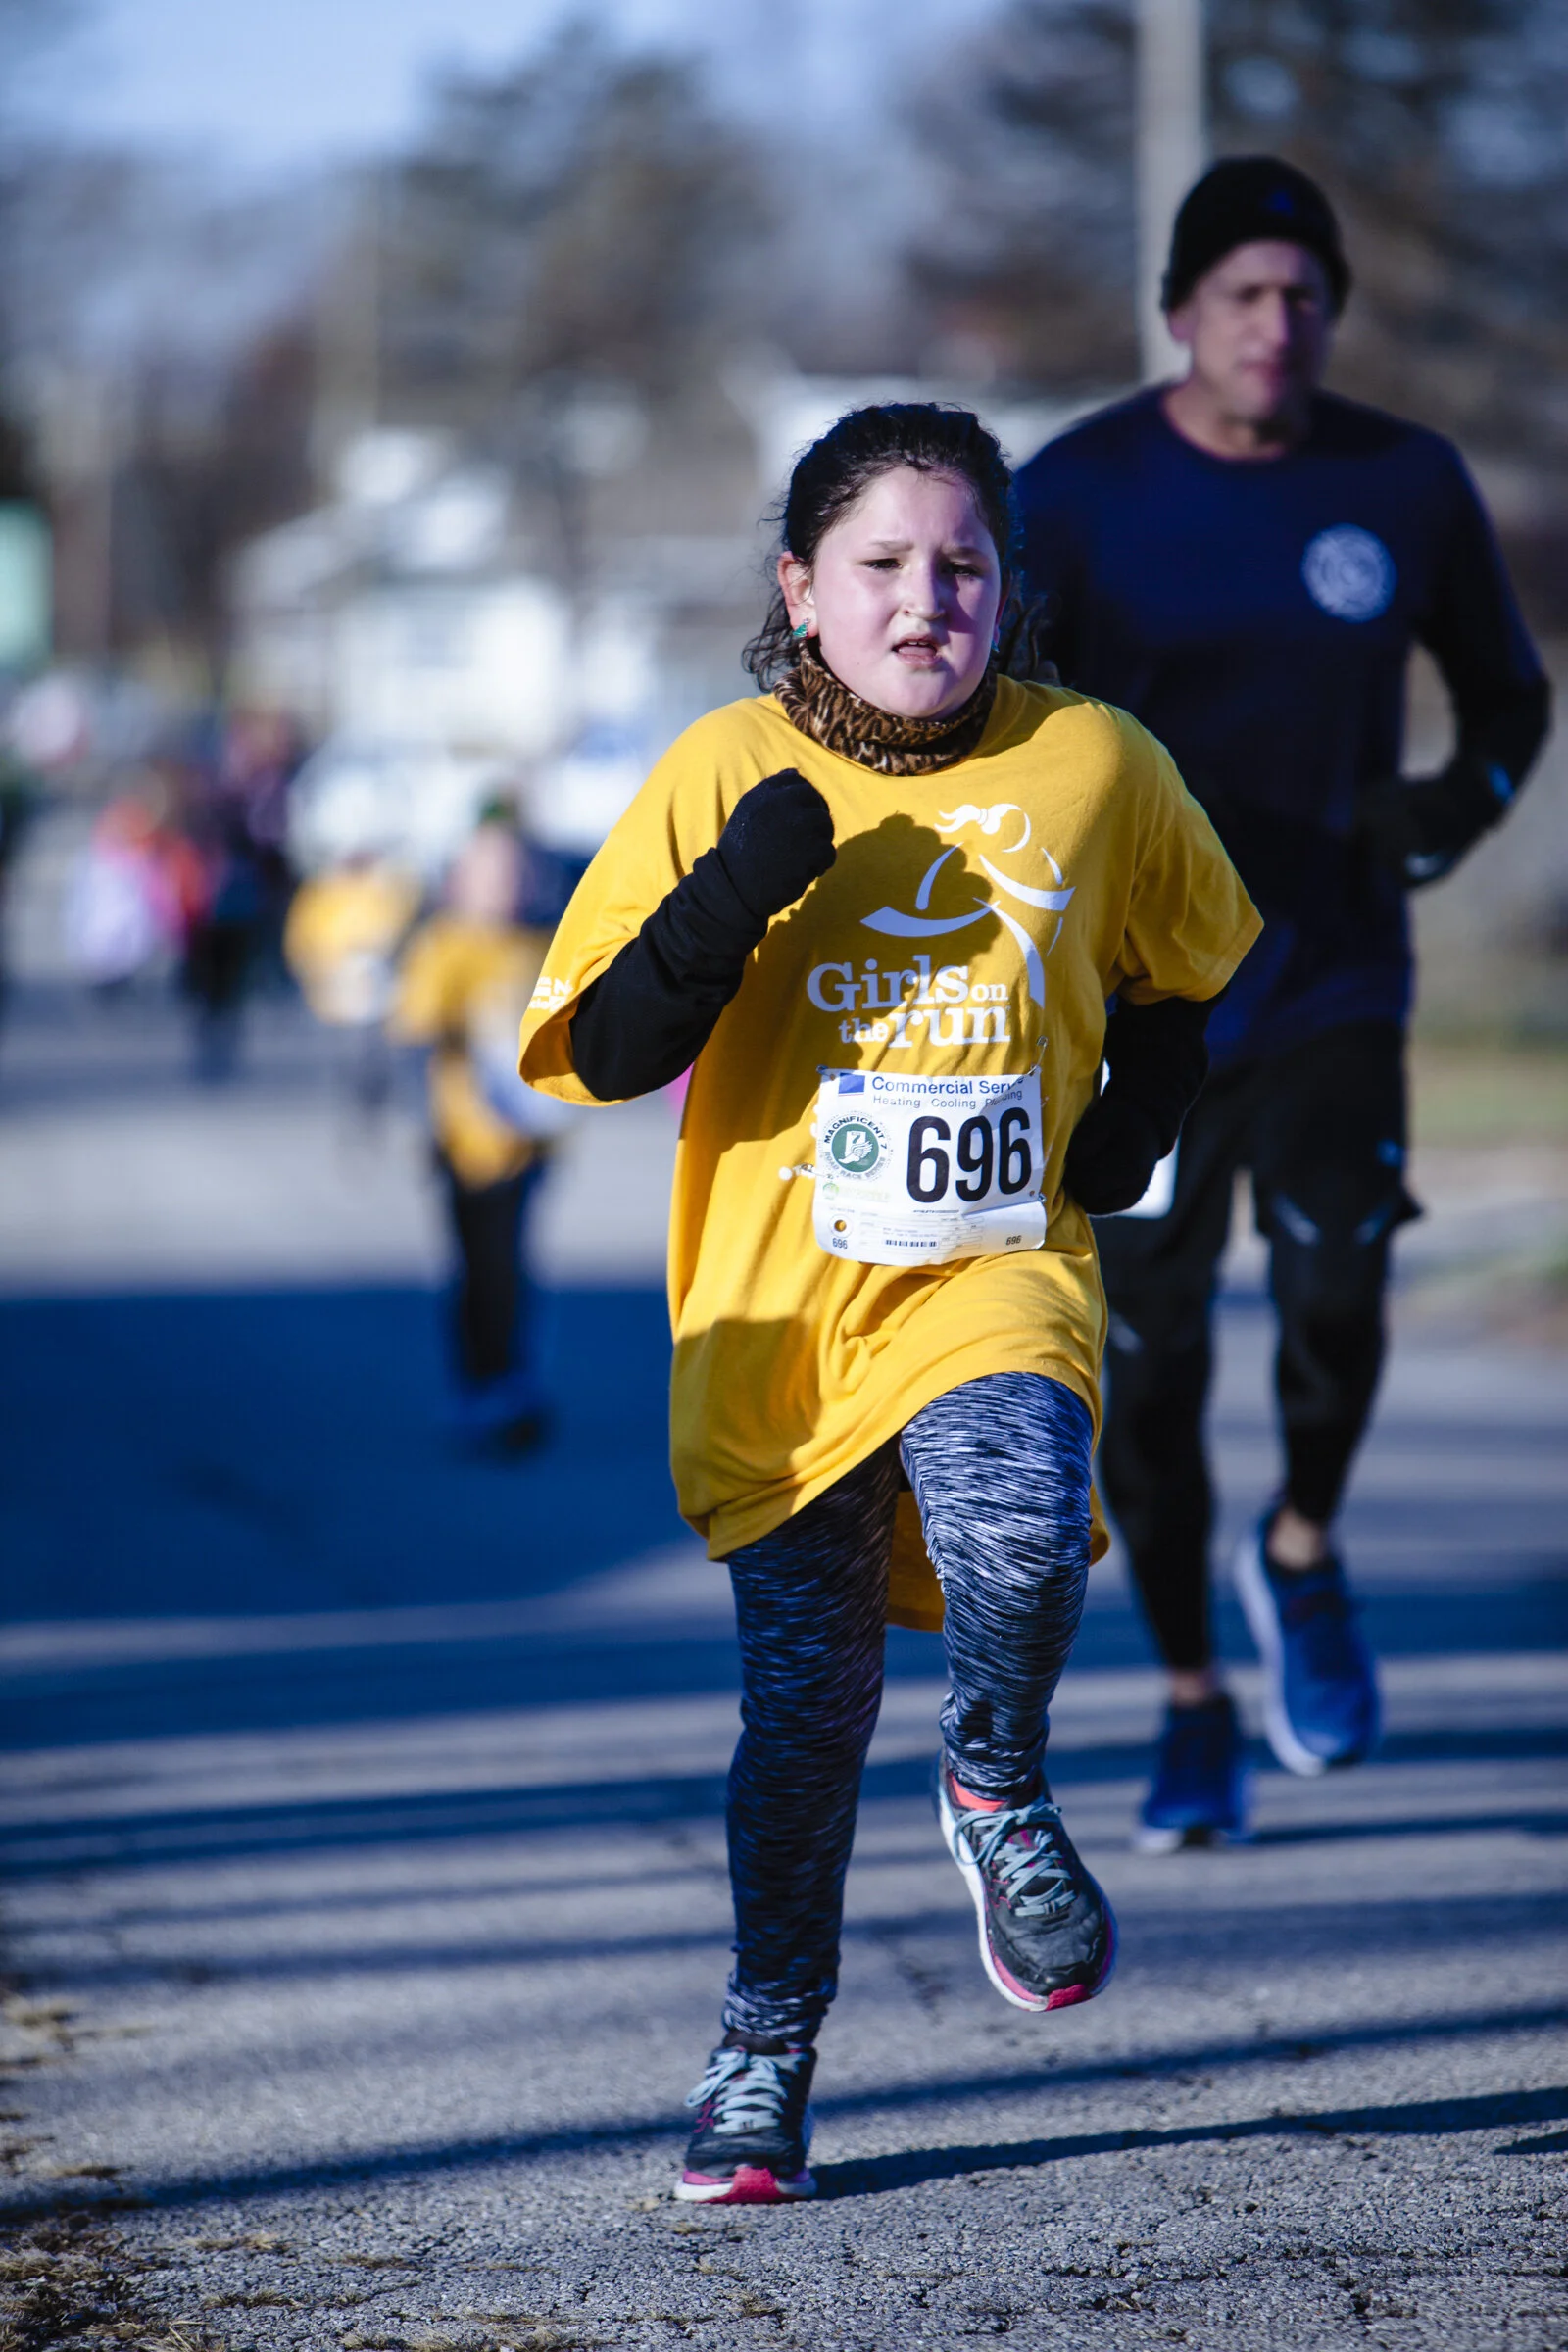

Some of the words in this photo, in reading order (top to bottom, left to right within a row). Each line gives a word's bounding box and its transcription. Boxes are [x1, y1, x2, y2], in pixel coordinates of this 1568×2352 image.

[807, 955, 969, 1011] Girls
[971, 983, 1008, 1001] on
[839, 1018, 889, 1044] the
[888, 1005, 1011, 1048] run
[872, 1076, 972, 1095] Commercial
[873, 1096, 920, 1108] Heating
[931, 1098, 976, 1109] Cooling
[824, 1116, 885, 1144] MAGNIFICENT
[906, 1106, 1032, 1203] 696
[832, 1237, 848, 1250] 696
[1005, 1235, 1022, 1246] 696
